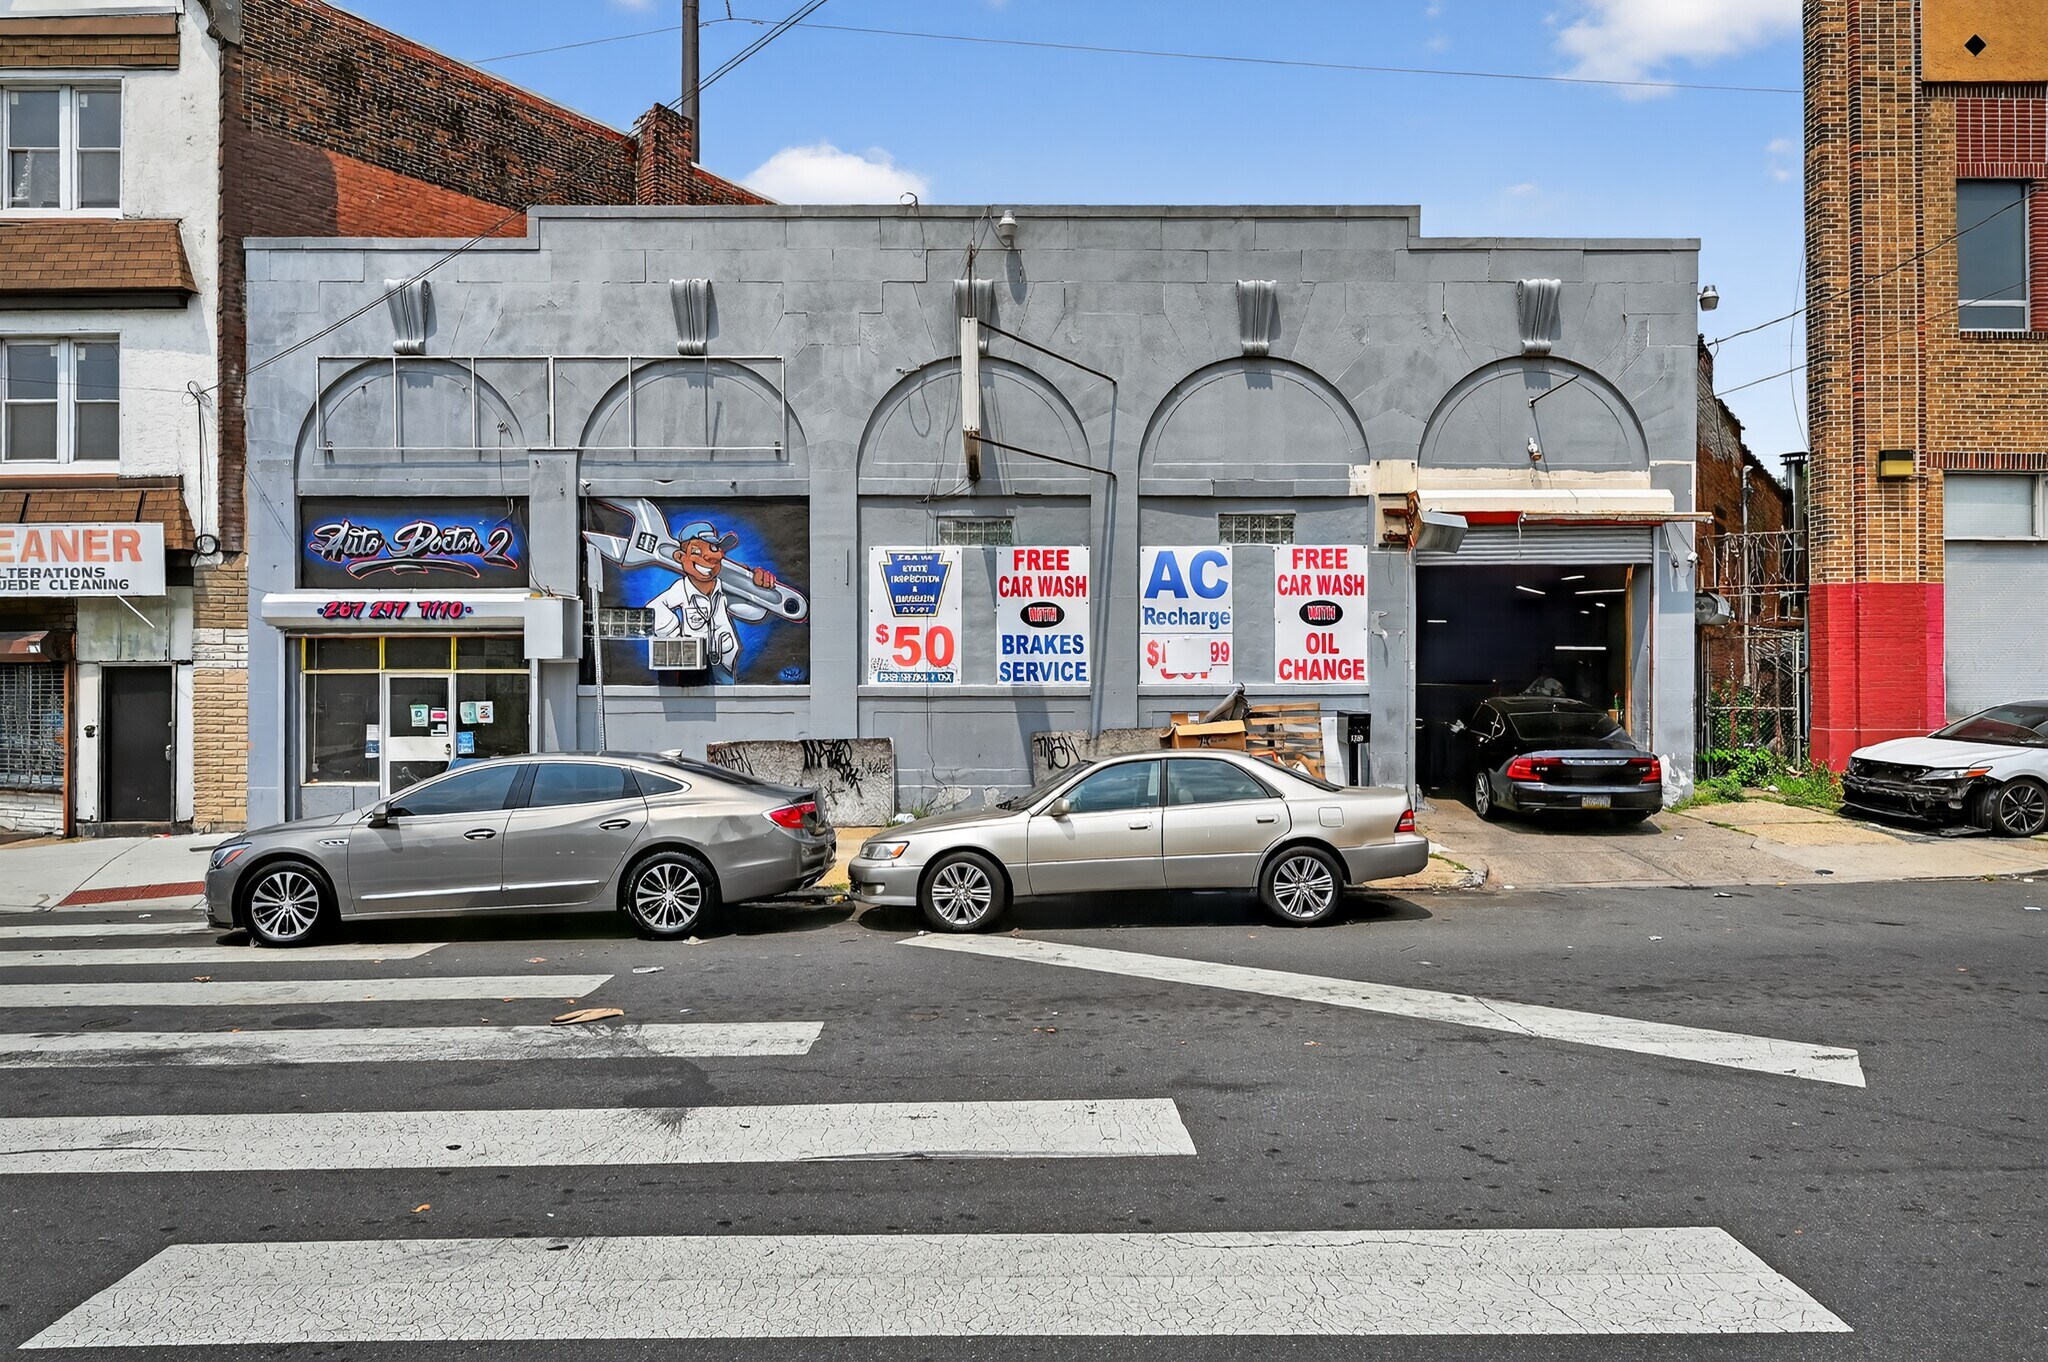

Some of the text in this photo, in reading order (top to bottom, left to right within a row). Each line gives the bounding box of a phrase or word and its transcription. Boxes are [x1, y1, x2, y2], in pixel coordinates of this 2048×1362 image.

[0, 529, 143, 563] EANER
[309, 519, 518, 569] Auto Doctor 2
[1013, 549, 1070, 572] FREE
[1292, 548, 1348, 570] FREE
[49, 578, 130, 591] CLEANING
[1144, 550, 1229, 599] AC
[1277, 574, 1365, 596] CAR WASH
[998, 575, 1087, 598] CAR WASH
[1144, 606, 1231, 630] Recharge
[875, 623, 955, 668] $50
[1002, 634, 1085, 655] BRAKES
[1305, 632, 1340, 655] OIL
[999, 661, 1087, 682] SERVICE
[1278, 658, 1365, 681] CHANGE
